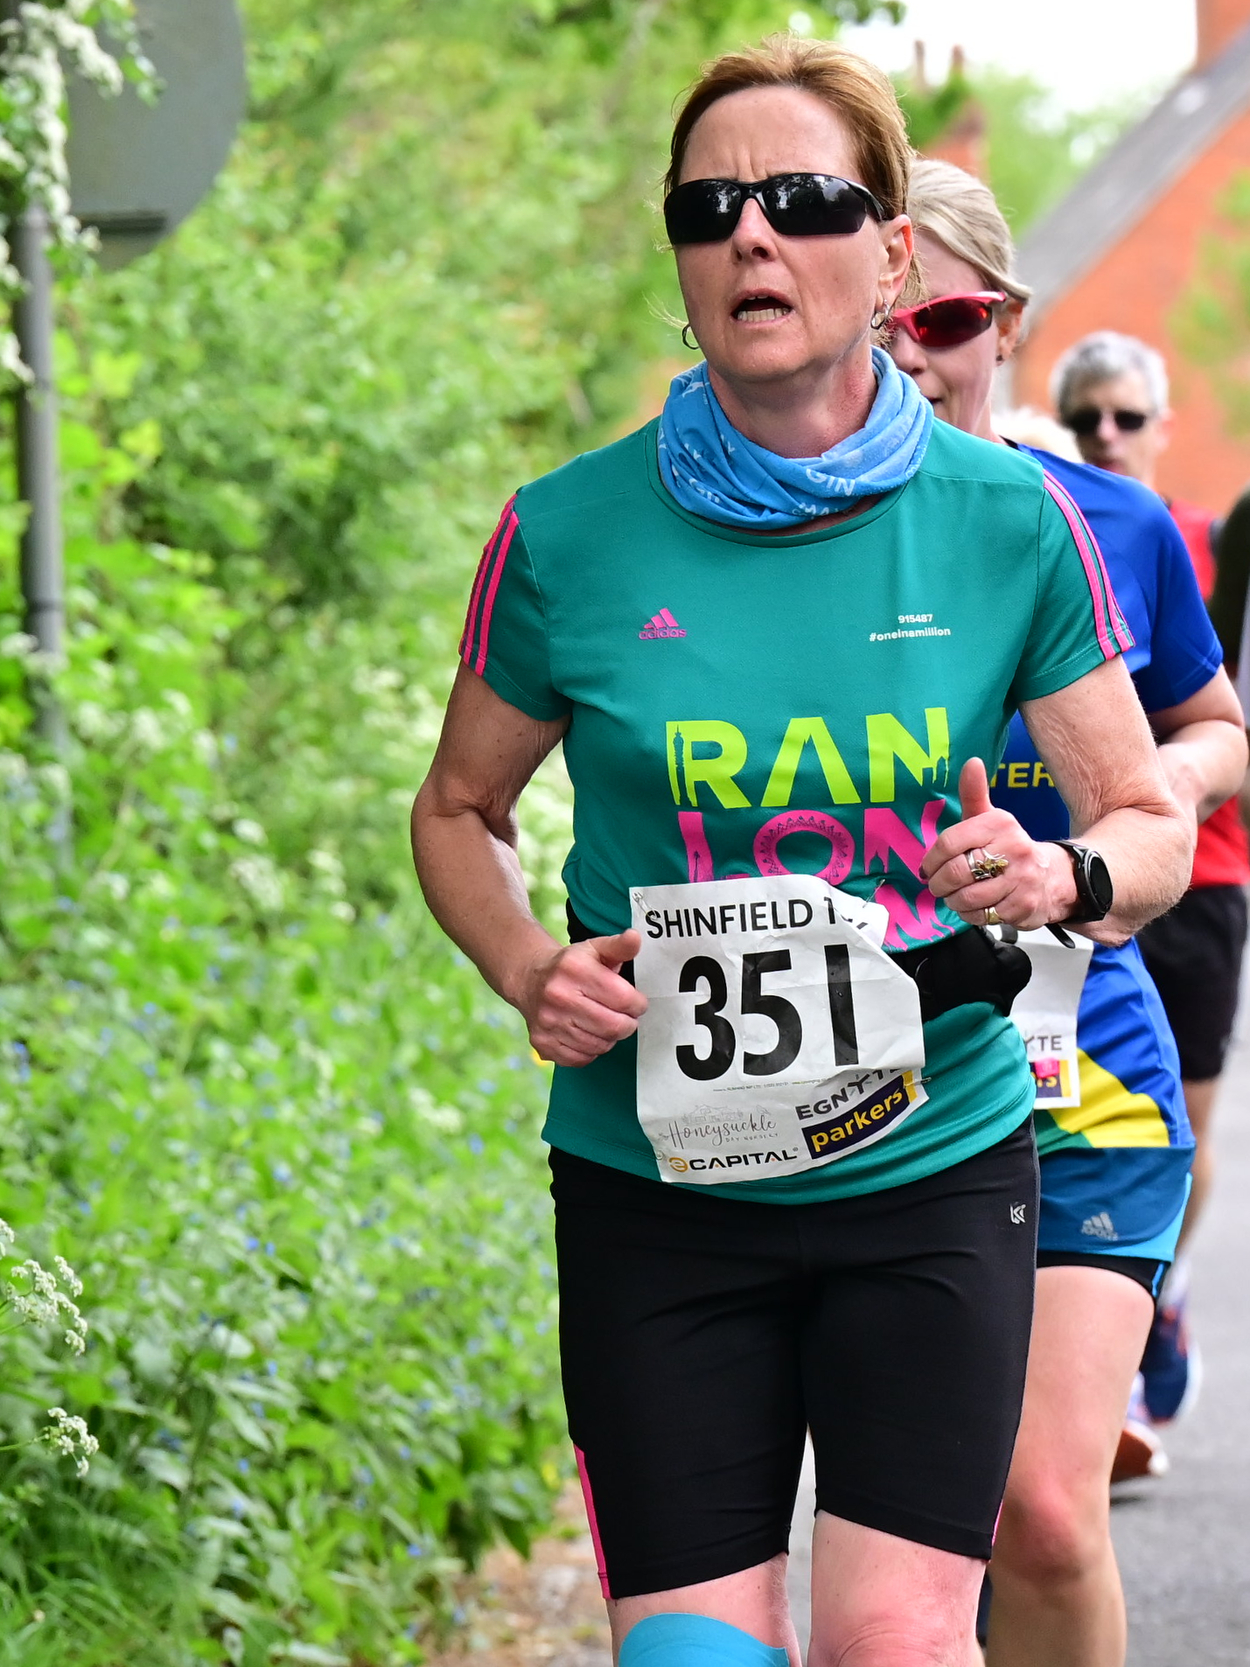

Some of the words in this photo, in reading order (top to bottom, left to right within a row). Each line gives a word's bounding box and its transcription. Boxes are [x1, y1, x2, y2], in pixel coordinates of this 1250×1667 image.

[638, 627, 687, 640] adidas
[869, 627, 951, 642] #oneinamillion
[897, 613, 933, 624] 915487
[665, 707, 951, 809] RAN
[645, 898, 813, 939] SHINFIELD
[675, 944, 859, 1081] 351
[668, 1113, 777, 1150] Honeysuckle
[810, 1087, 904, 1152] parkers
